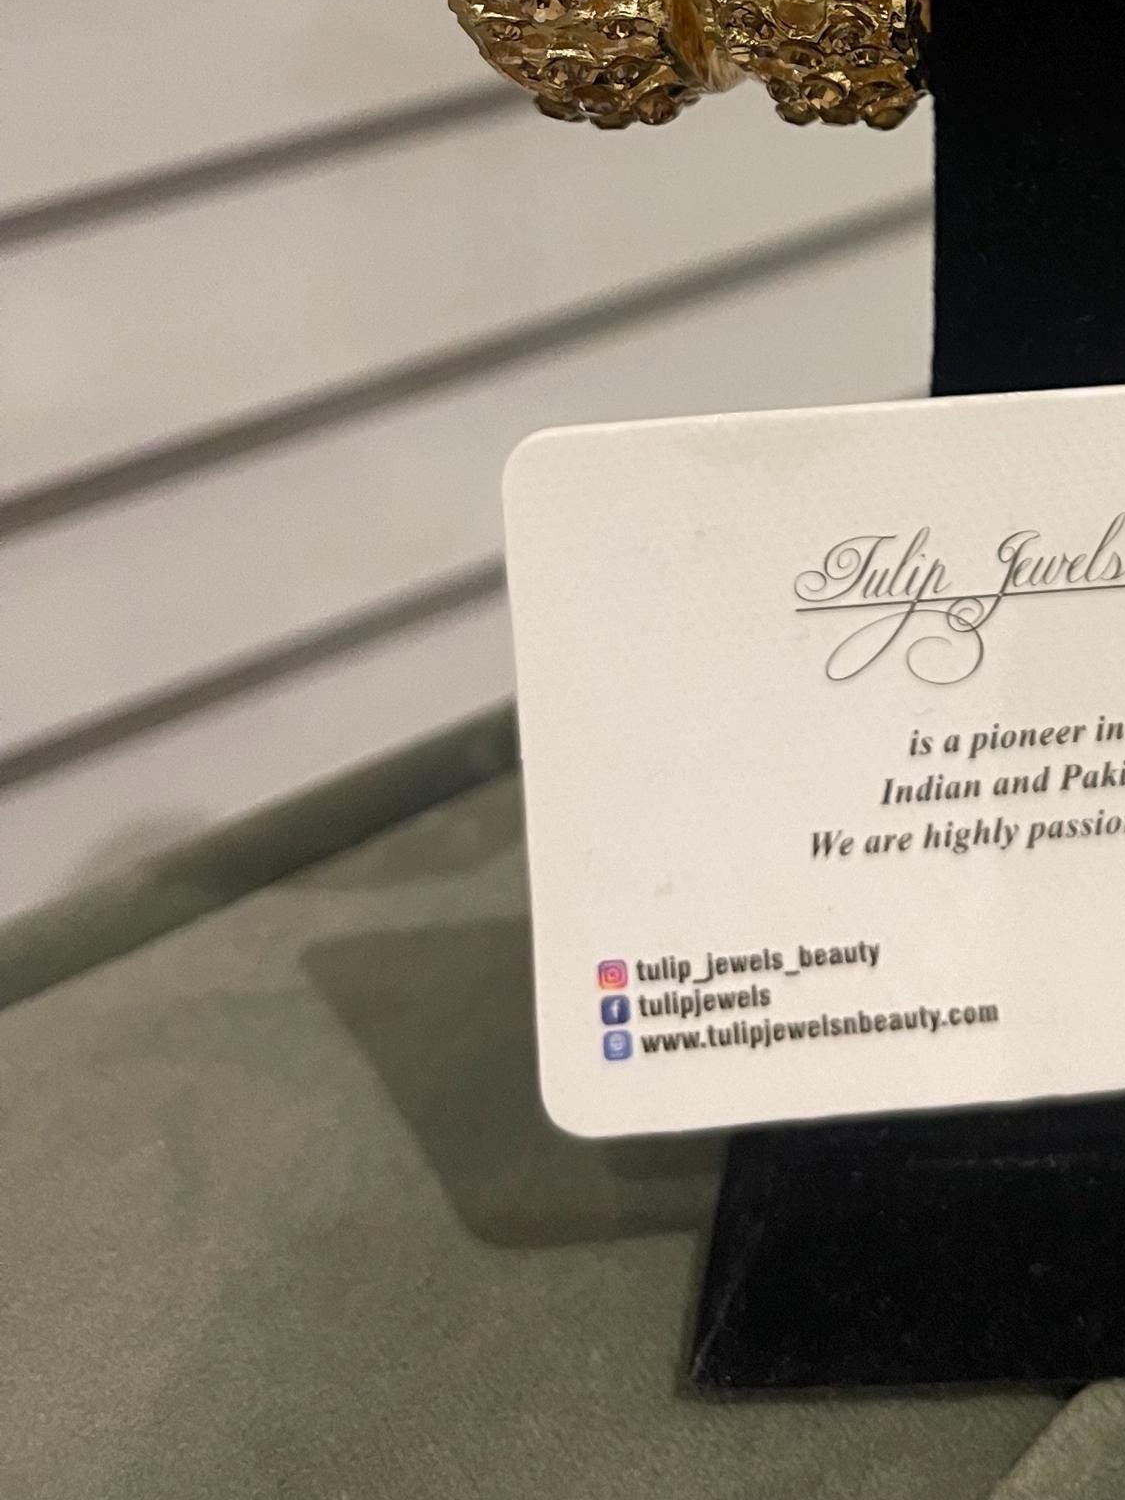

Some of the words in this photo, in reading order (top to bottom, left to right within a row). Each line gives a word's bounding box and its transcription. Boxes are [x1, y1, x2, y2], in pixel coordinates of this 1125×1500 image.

[794, 526, 984, 684] Tulip
[909, 730, 933, 757] is
[943, 732, 961, 755] a
[969, 722, 1087, 759] pioneer
[1097, 716, 1124, 743] in
[881, 774, 982, 806] Indian
[993, 767, 1050, 797] and
[809, 829, 854, 861] We
[864, 832, 913, 856] are
[923, 818, 1019, 853] highly
[635, 940, 880, 983] tulip_jewels_beauty
[639, 984, 772, 1018] tulipjewels
[641, 1003, 999, 1053] www.tulipjewelsnbeauty.com
